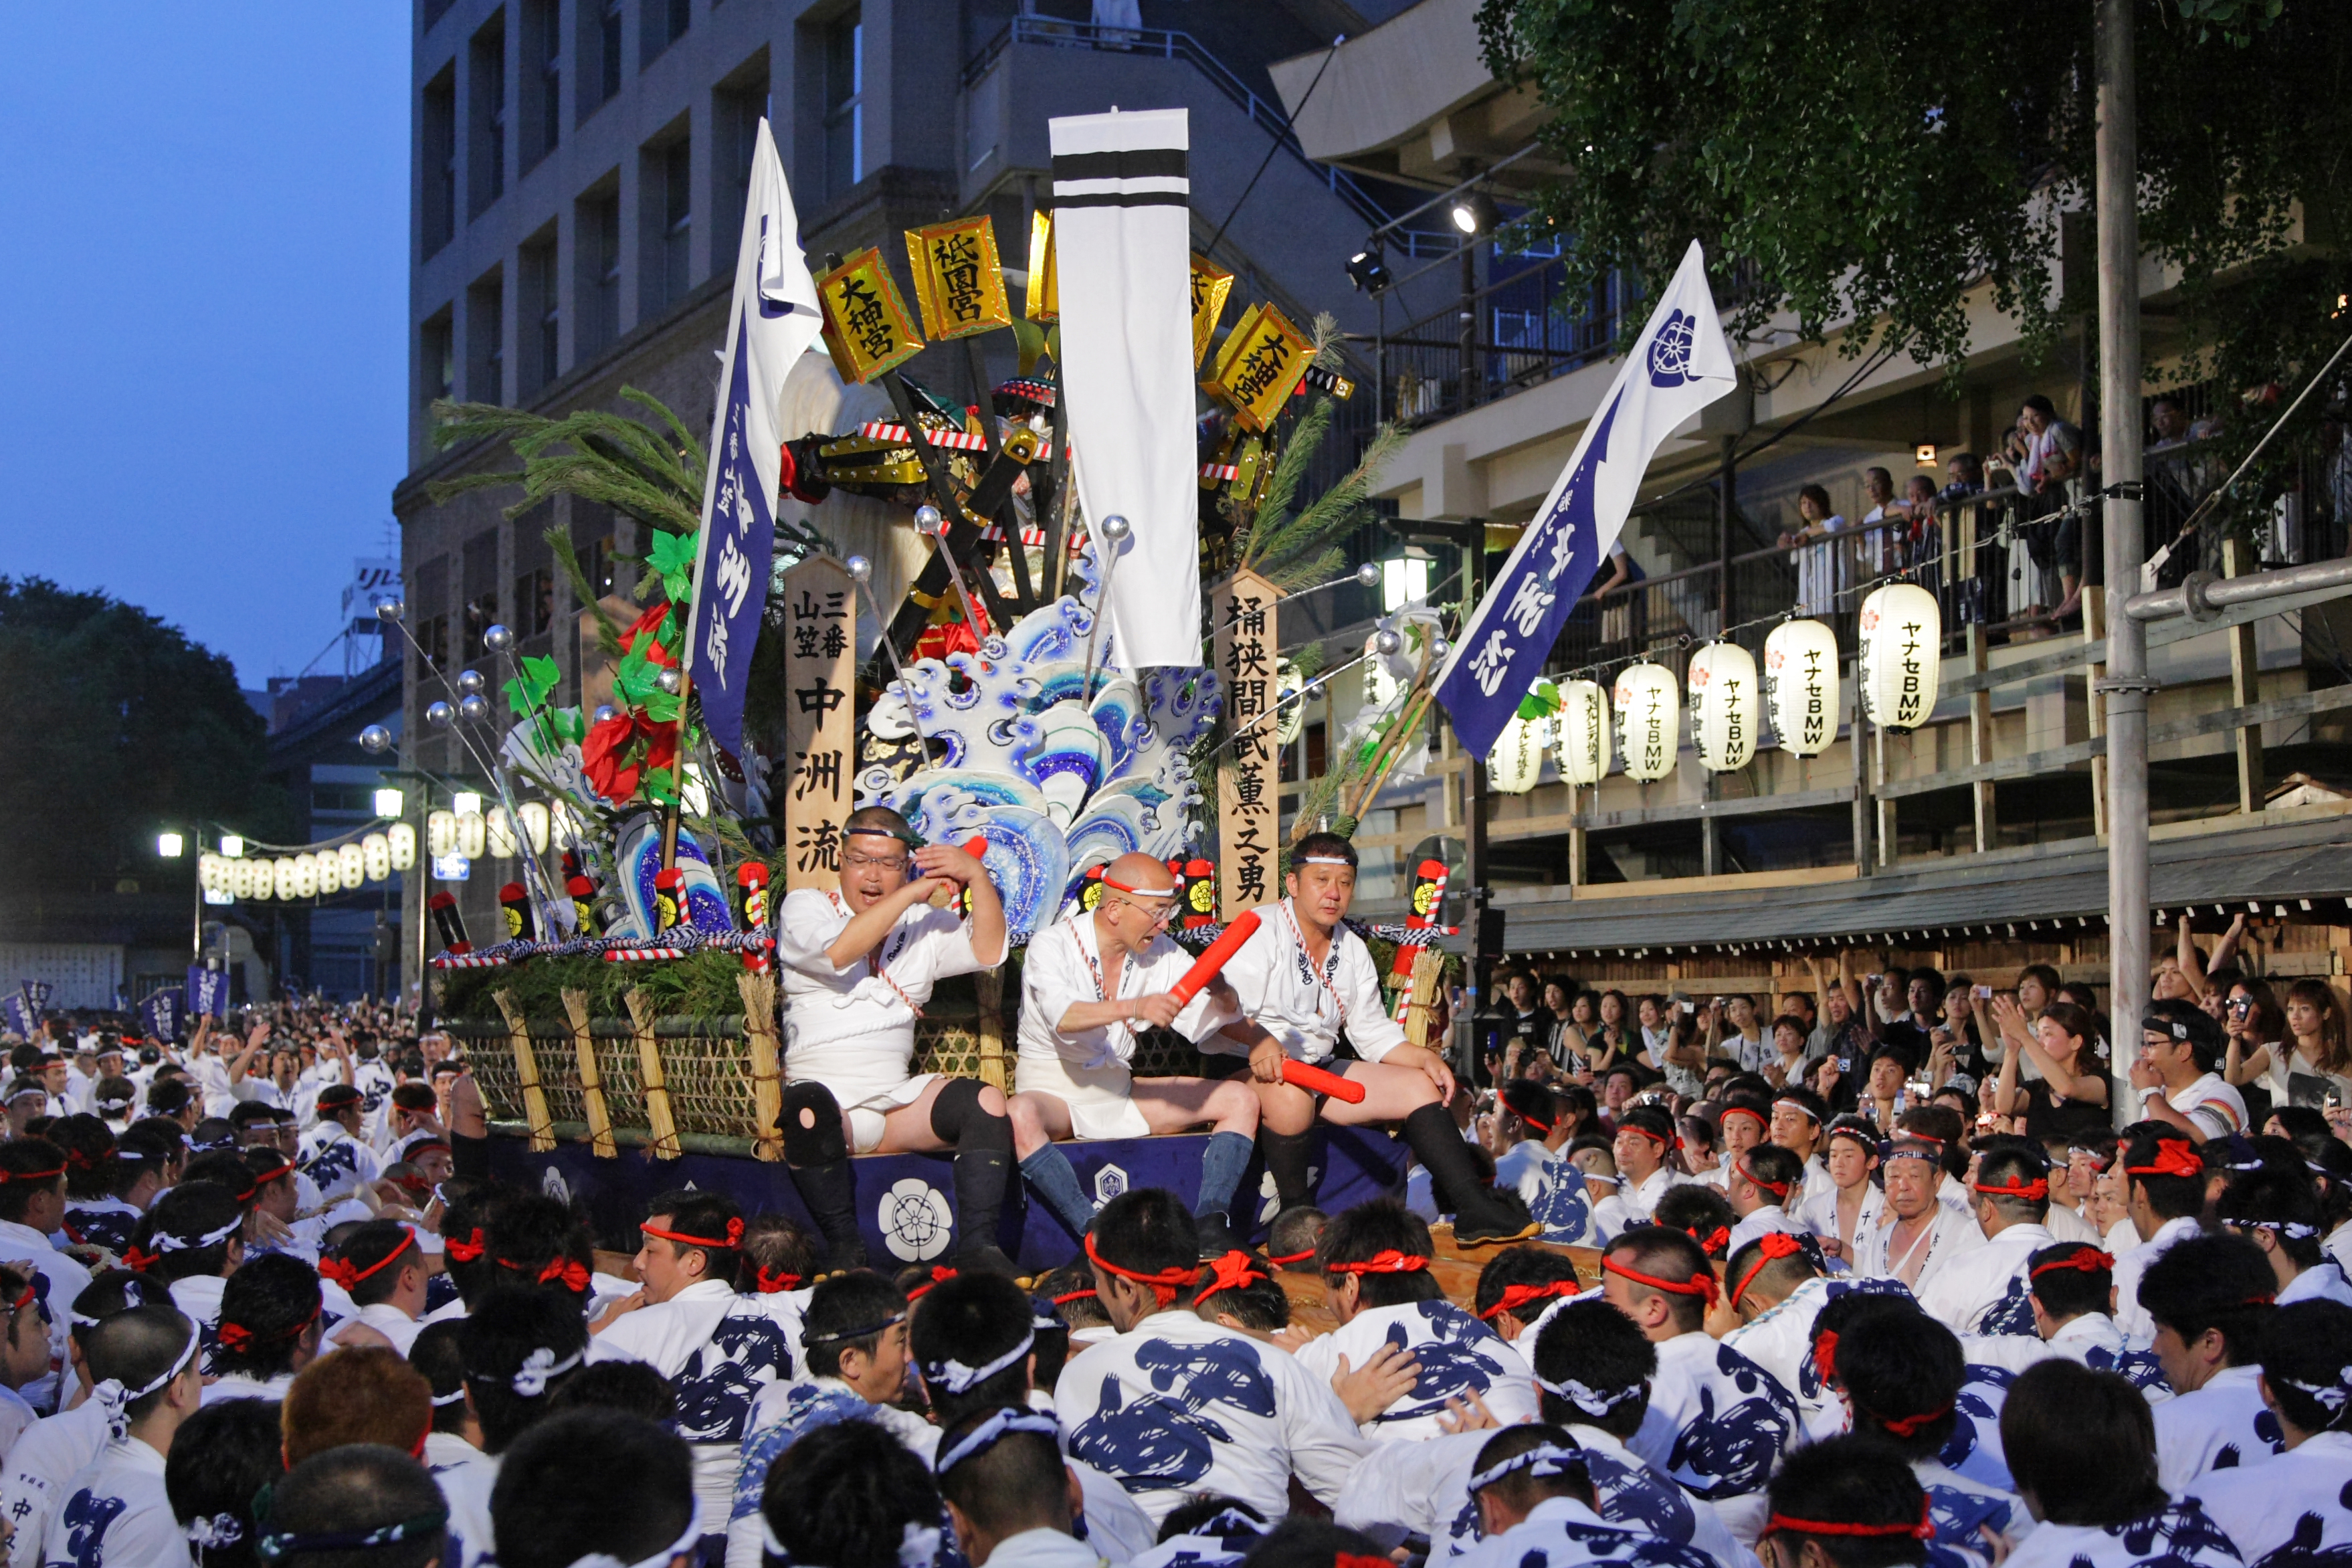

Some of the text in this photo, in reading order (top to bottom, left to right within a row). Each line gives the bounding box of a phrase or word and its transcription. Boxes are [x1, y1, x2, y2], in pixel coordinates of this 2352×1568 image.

[839, 275, 894, 361] 大神宮
[1232, 333, 1289, 407] 大神宮
[793, 590, 820, 659] 山笠
[821, 591, 849, 659] 三番
[1804, 650, 1824, 745] ヤナセBMW
[1898, 622, 1921, 721] ヤナセBMW
[1645, 687, 1662, 771] ヤナセBMW
[1724, 678, 1743, 765] ヤナセBMW
[794, 677, 846, 874] 中洲流
